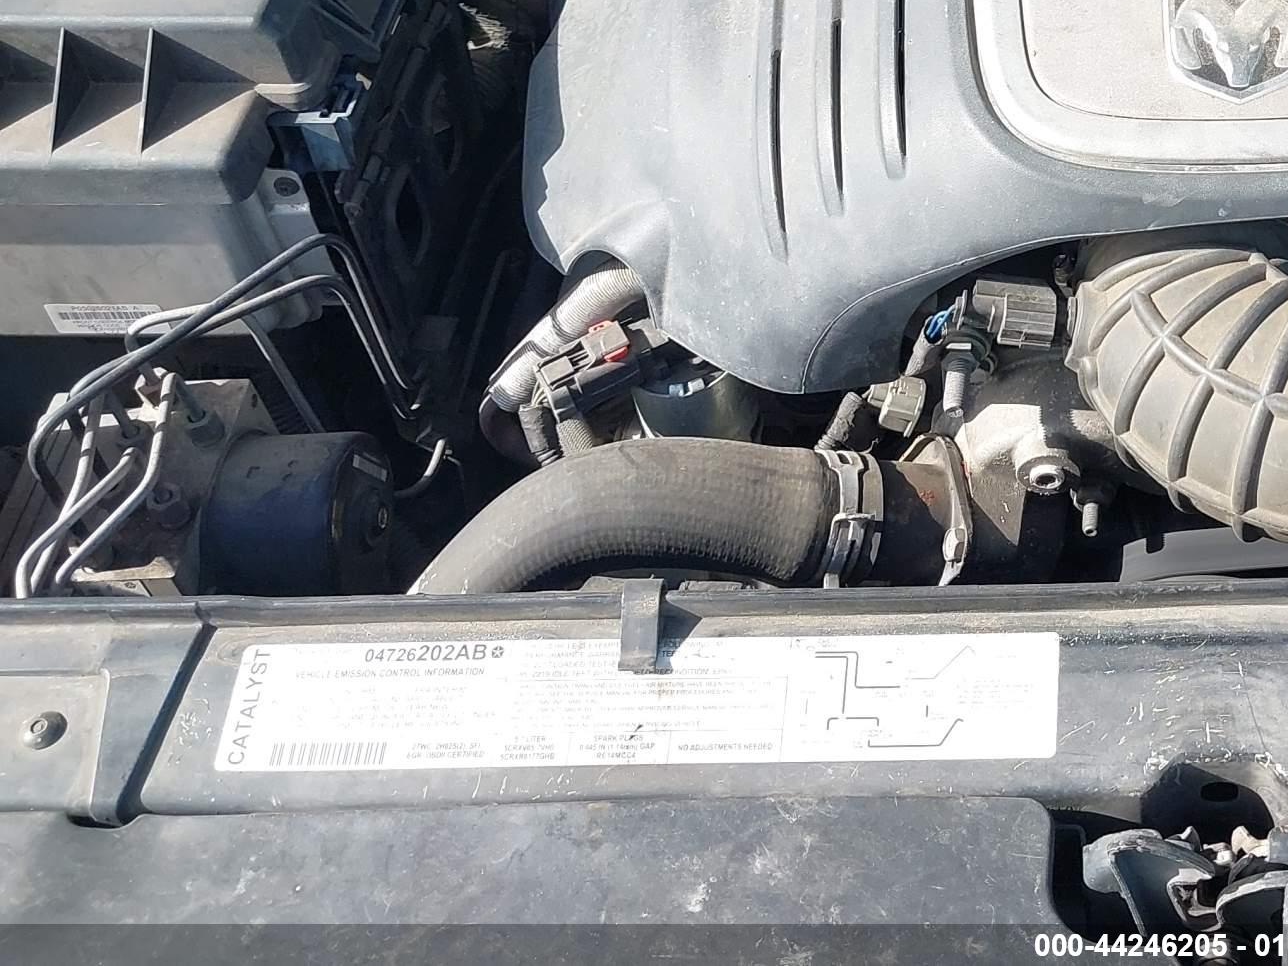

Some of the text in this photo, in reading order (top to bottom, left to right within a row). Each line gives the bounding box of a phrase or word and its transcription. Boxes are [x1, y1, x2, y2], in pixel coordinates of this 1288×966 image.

[364, 644, 487, 663] 04726202AB
[334, 668, 377, 678] EMISSION
[379, 667, 421, 677] CONTROL
[424, 667, 485, 676] INFORMATION
[228, 649, 270, 765] CATALYST
[639, 742, 656, 750] GAP
[689, 743, 742, 751] ADJUSTMENTS
[744, 742, 773, 750] NEEDED
